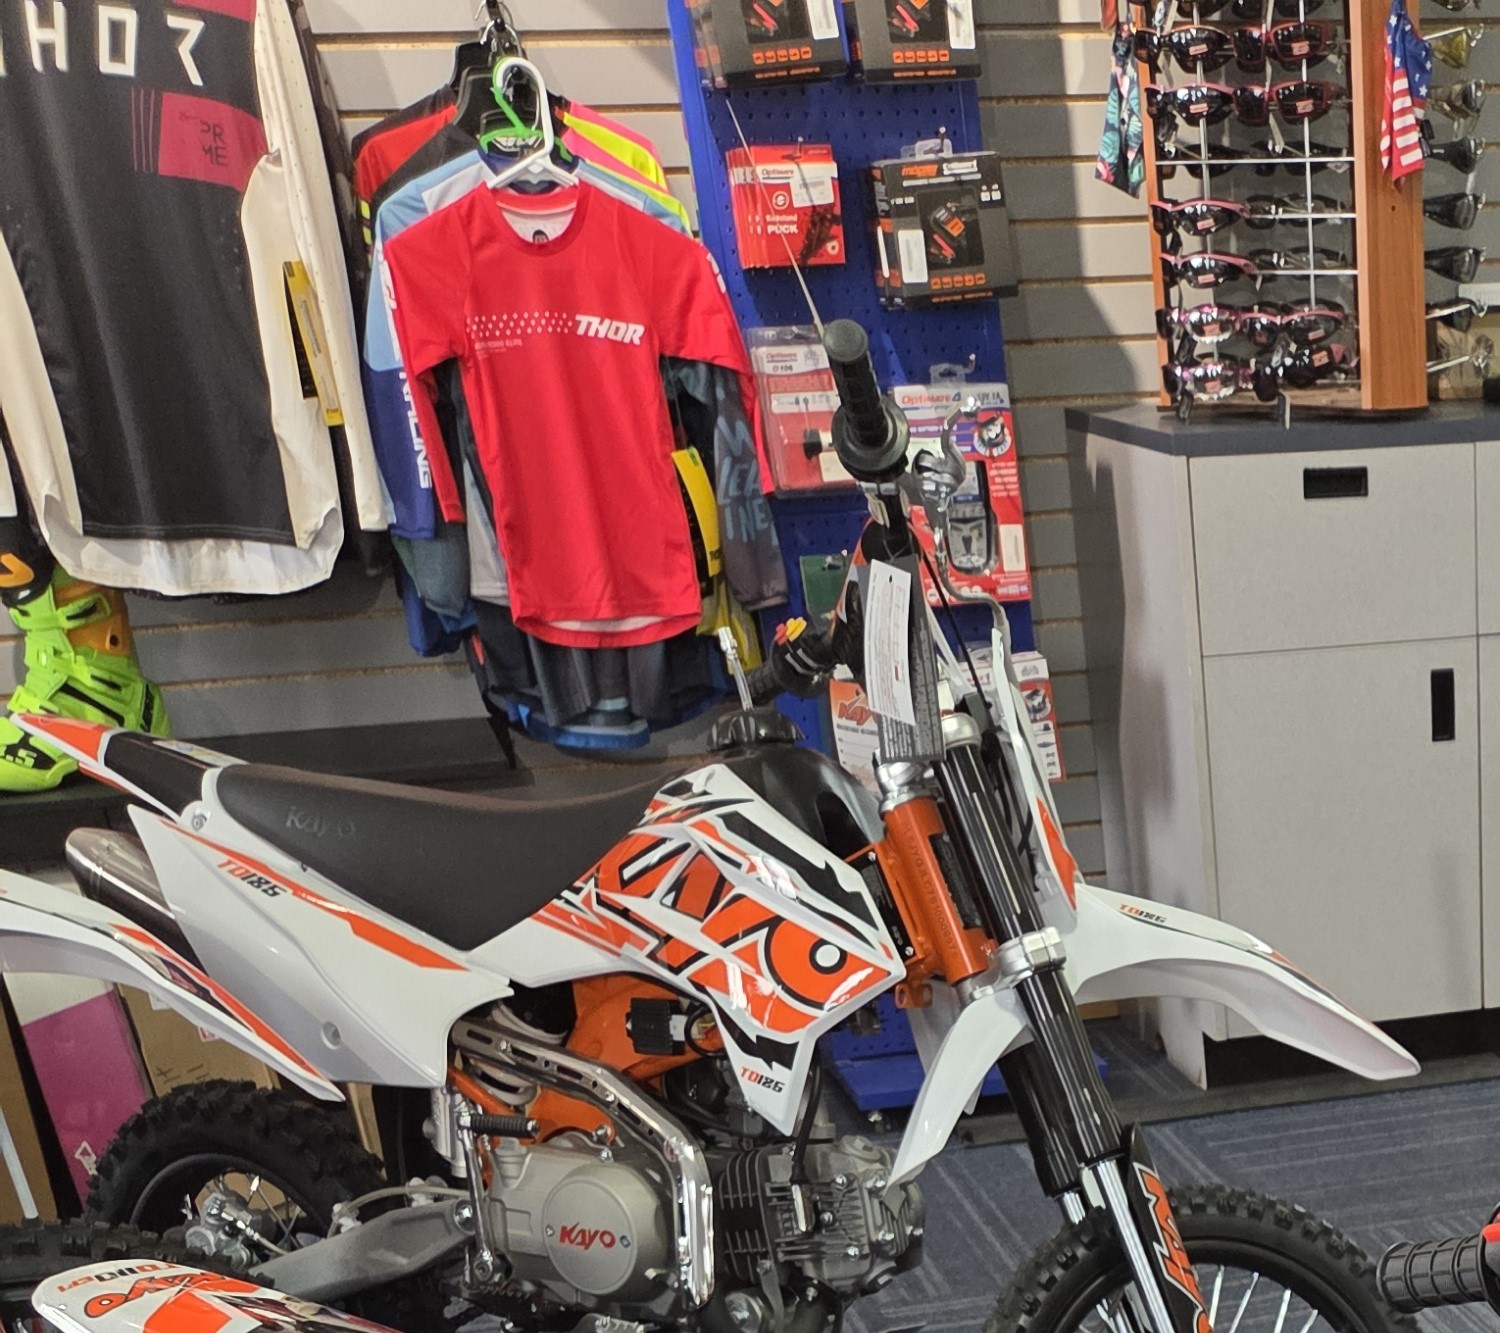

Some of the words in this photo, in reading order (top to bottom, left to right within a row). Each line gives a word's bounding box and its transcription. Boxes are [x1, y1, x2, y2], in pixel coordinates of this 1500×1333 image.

[767, 224, 798, 234] PUCK
[575, 313, 645, 346] THOR
[559, 1222, 616, 1250] KAYO
